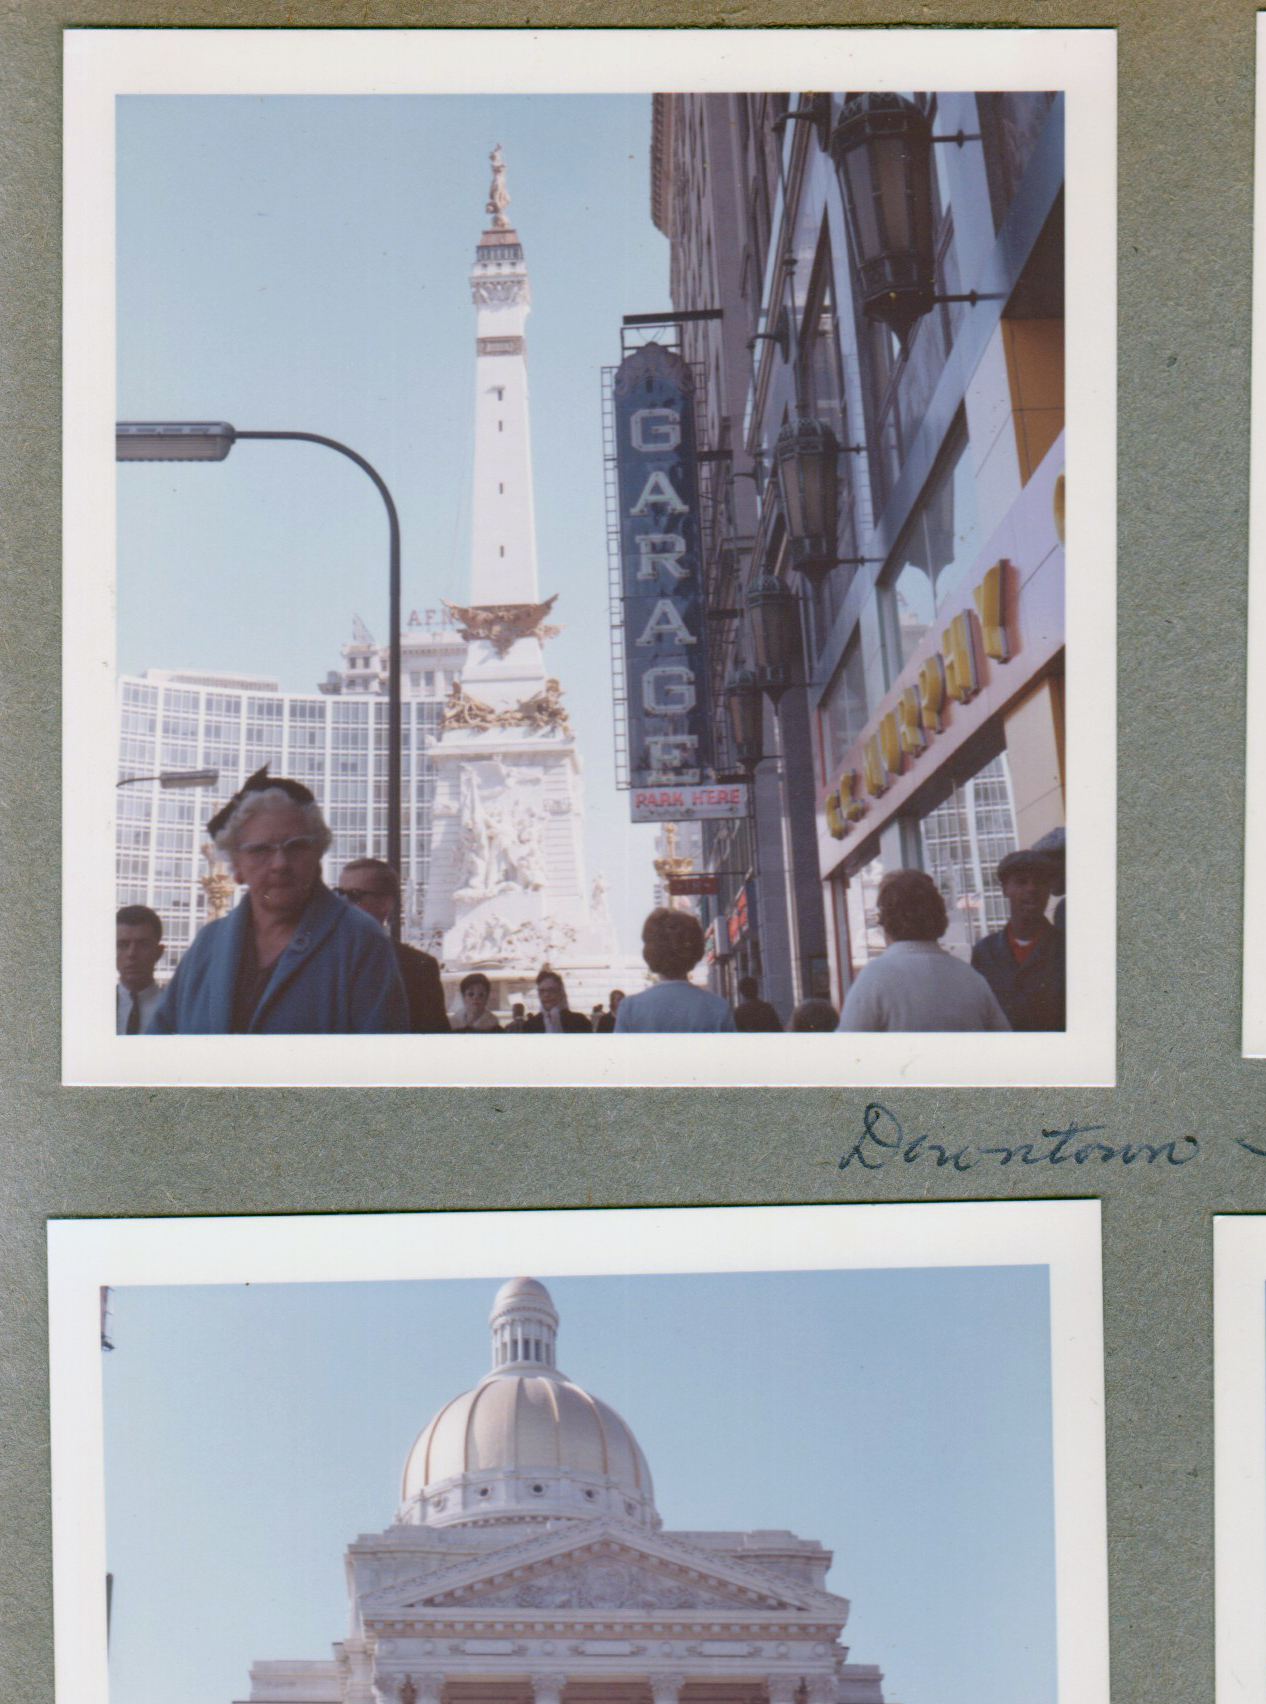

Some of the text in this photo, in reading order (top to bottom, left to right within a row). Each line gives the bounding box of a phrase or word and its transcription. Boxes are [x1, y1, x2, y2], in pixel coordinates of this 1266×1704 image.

[630, 408, 699, 785] GARAGE
[863, 558, 1011, 799] MURPHY
[636, 788, 740, 809] PARK HERE
[838, 1101, 1198, 1172] Downtown
